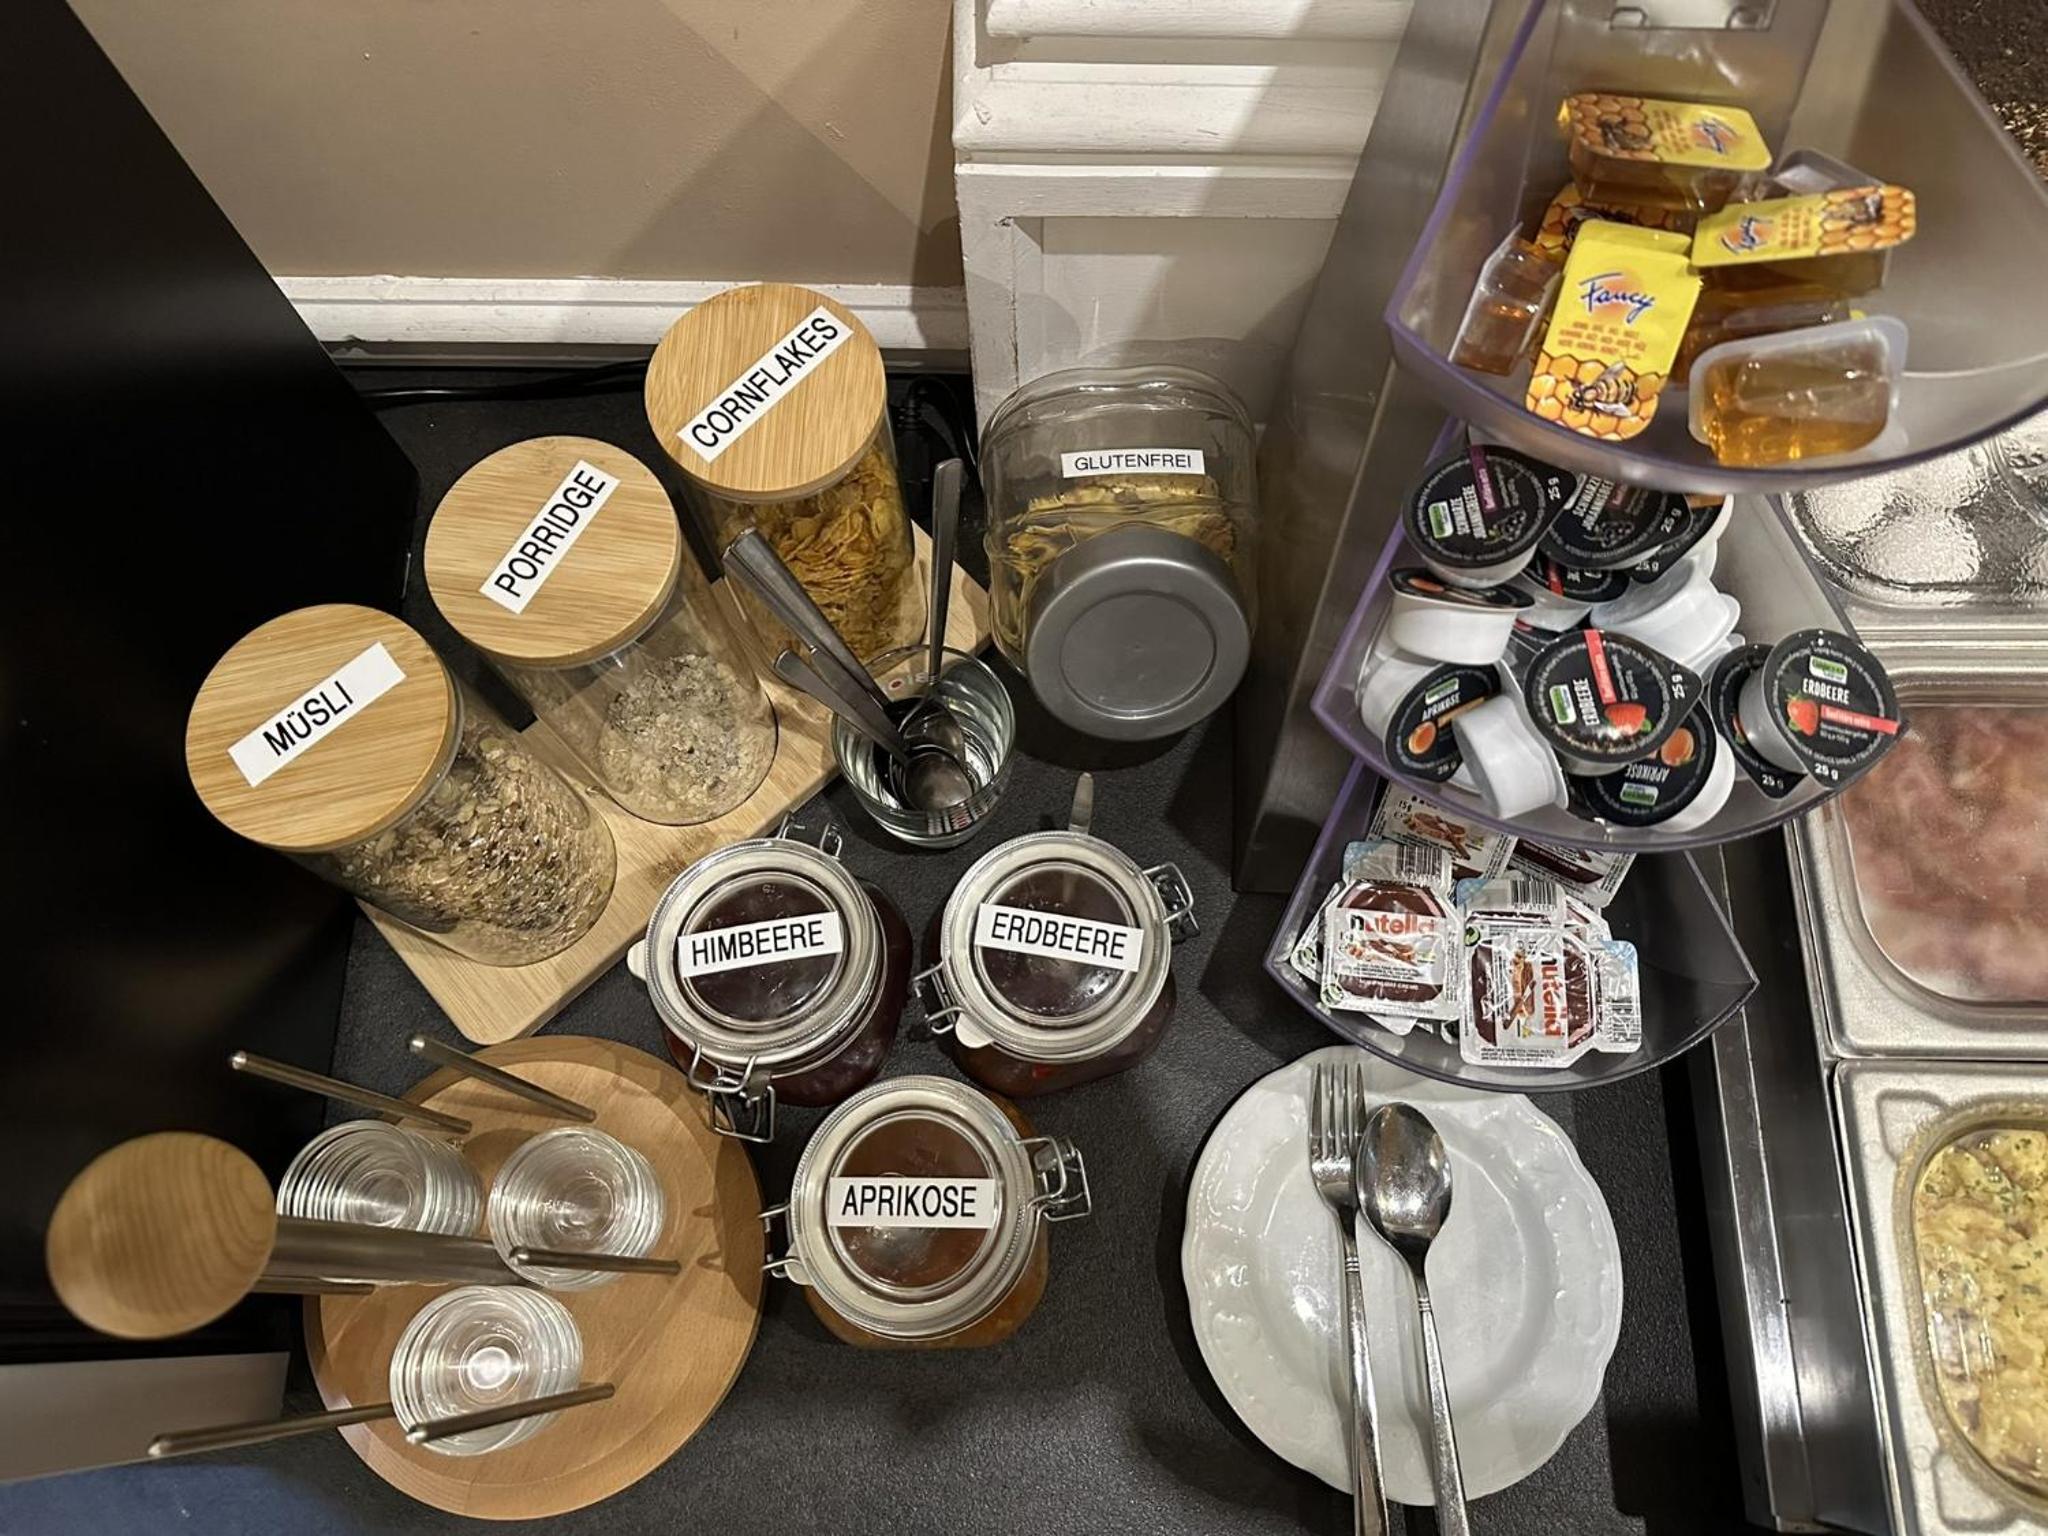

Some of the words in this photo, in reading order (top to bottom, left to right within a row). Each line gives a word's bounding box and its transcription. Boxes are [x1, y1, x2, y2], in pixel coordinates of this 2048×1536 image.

[1578, 272, 1655, 324] Fancy
[691, 316, 838, 449] CORNFLAKES
[1074, 453, 1192, 471] GLUTENFREI
[1547, 477, 1560, 486] g
[1547, 486, 1561, 501] 25
[494, 468, 606, 598] PORRIDGE
[1661, 517, 1675, 533] 25
[1671, 508, 1682, 519] g
[1672, 675, 1683, 685] g
[1673, 684, 1687, 700] 25
[1802, 677, 1850, 704] ERDBEERE
[262, 681, 353, 757] MÜSLI
[1421, 694, 1462, 722] APRIKOSE
[1626, 763, 1671, 783] APRIKOSE
[1761, 774, 1776, 786] 25
[1814, 763, 1830, 776] 25
[1831, 768, 1839, 781] g
[990, 912, 1128, 961] ERDBEERE
[1350, 913, 1435, 936] nutella
[691, 919, 826, 967] HIMBEERE
[1541, 951, 1567, 1037] nutella
[841, 1185, 977, 1218] APRIKOSE
